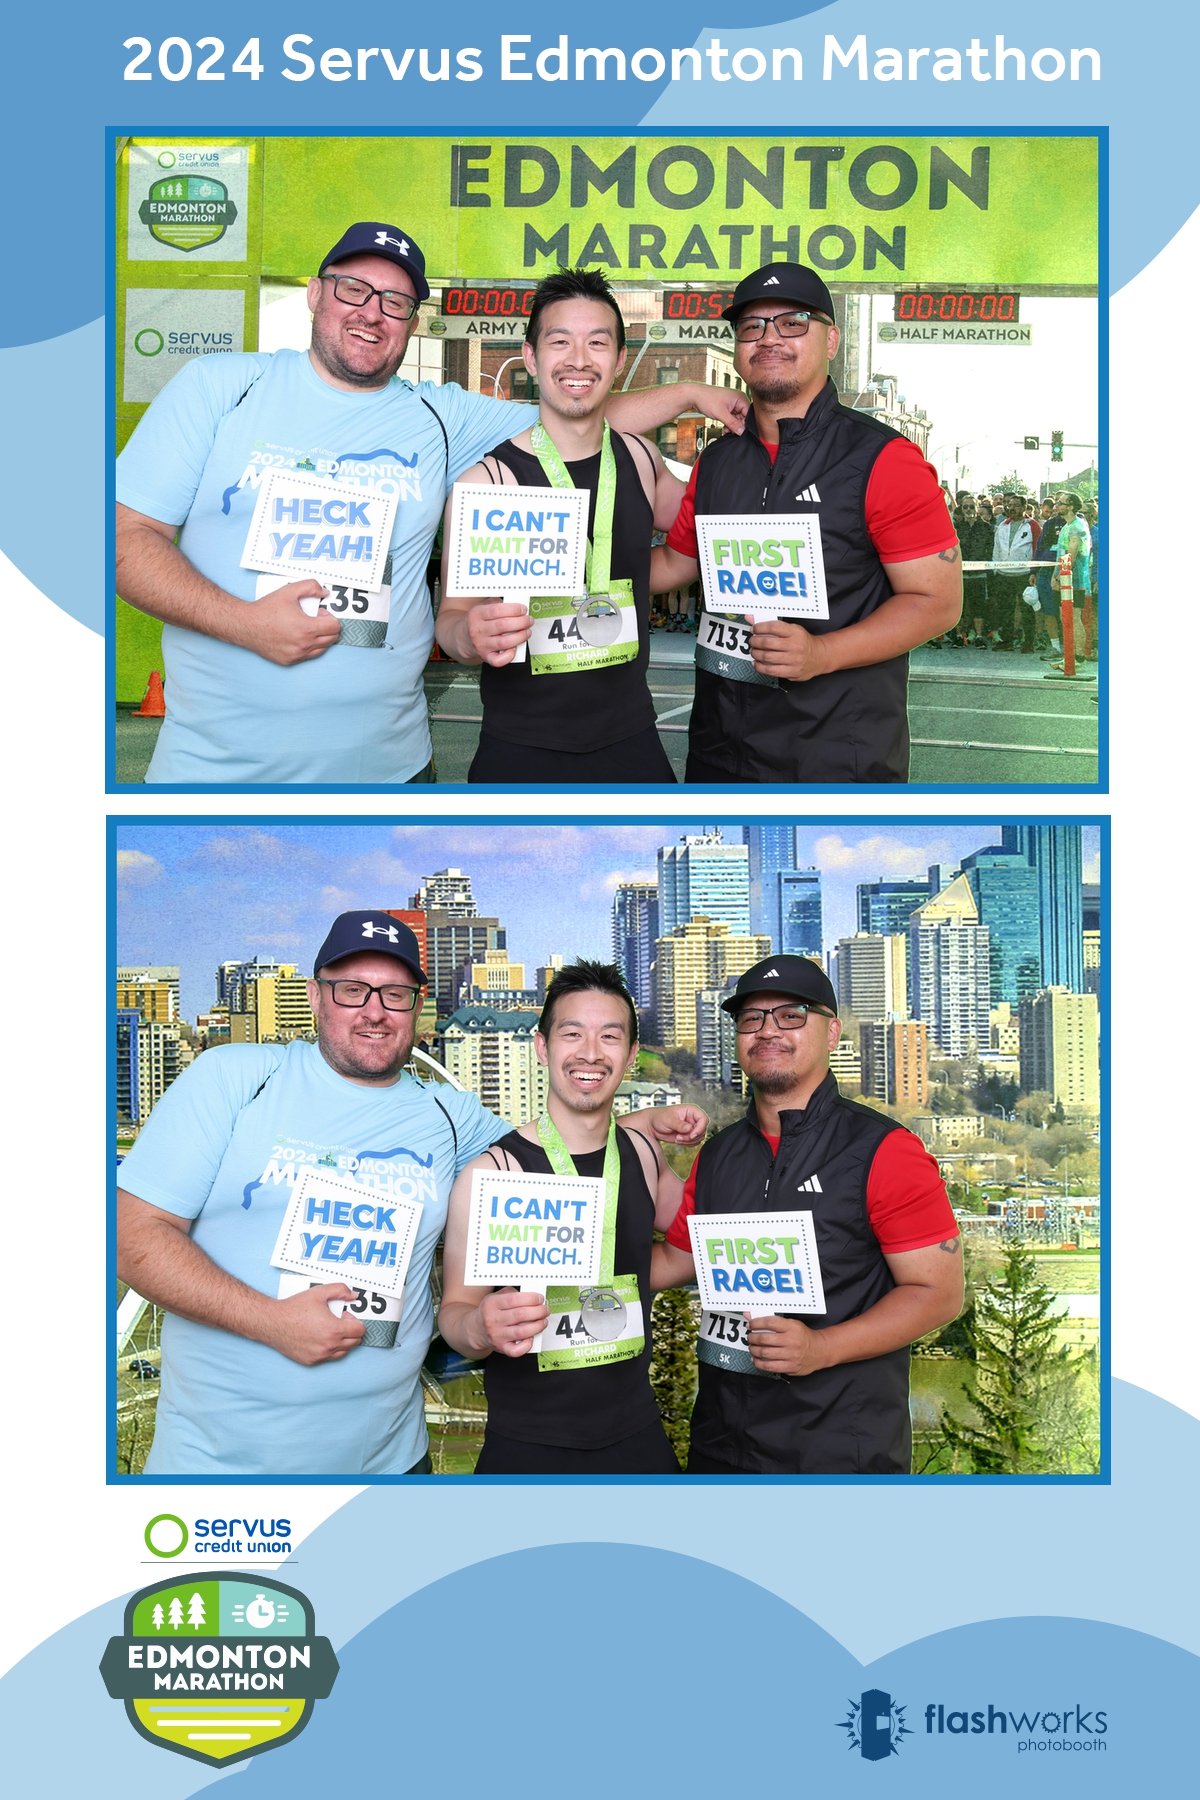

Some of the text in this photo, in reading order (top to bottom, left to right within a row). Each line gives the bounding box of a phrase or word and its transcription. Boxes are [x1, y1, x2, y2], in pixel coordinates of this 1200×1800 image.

[178, 152, 219, 161] servus
[450, 144, 990, 211] EDMONTON
[149, 203, 227, 214] EDMONTON
[160, 214, 215, 222] MARATHON
[523, 222, 906, 271] MARATHON
[466, 321, 517, 335] ARMY
[900, 328, 1031, 340] HALF MARATHON
[168, 332, 233, 345] servus
[168, 346, 200, 354] credit
[248, 450, 420, 480] 2024 EDMONTON
[271, 497, 371, 528] HECK
[472, 509, 570, 532] I CAN'T
[269, 532, 374, 562] YEAH!
[470, 536, 568, 554] WAIT FOR
[712, 539, 805, 567] FIRST
[468, 558, 566, 576] BRUNCH.
[717, 569, 808, 598] RACE!
[706, 620, 753, 655] 7133
[566, 648, 609, 661] RICHARD
[595, 654, 629, 665] MARATHON
[718, 661, 729, 672] 5K
[270, 1145, 436, 1180] 2024 EDMONTON
[303, 1197, 397, 1234] HECK
[490, 1196, 587, 1221] I CAN'T
[488, 1224, 585, 1243] WAIT FOR
[299, 1232, 397, 1269] YEAH!
[486, 1246, 582, 1265] BRUNCH.
[705, 1237, 799, 1264] FIRST
[711, 1267, 804, 1294] RACE!
[574, 1344, 617, 1357] RICHARD
[603, 1349, 635, 1361] MARATHON
[719, 1354, 730, 1364] 5K
